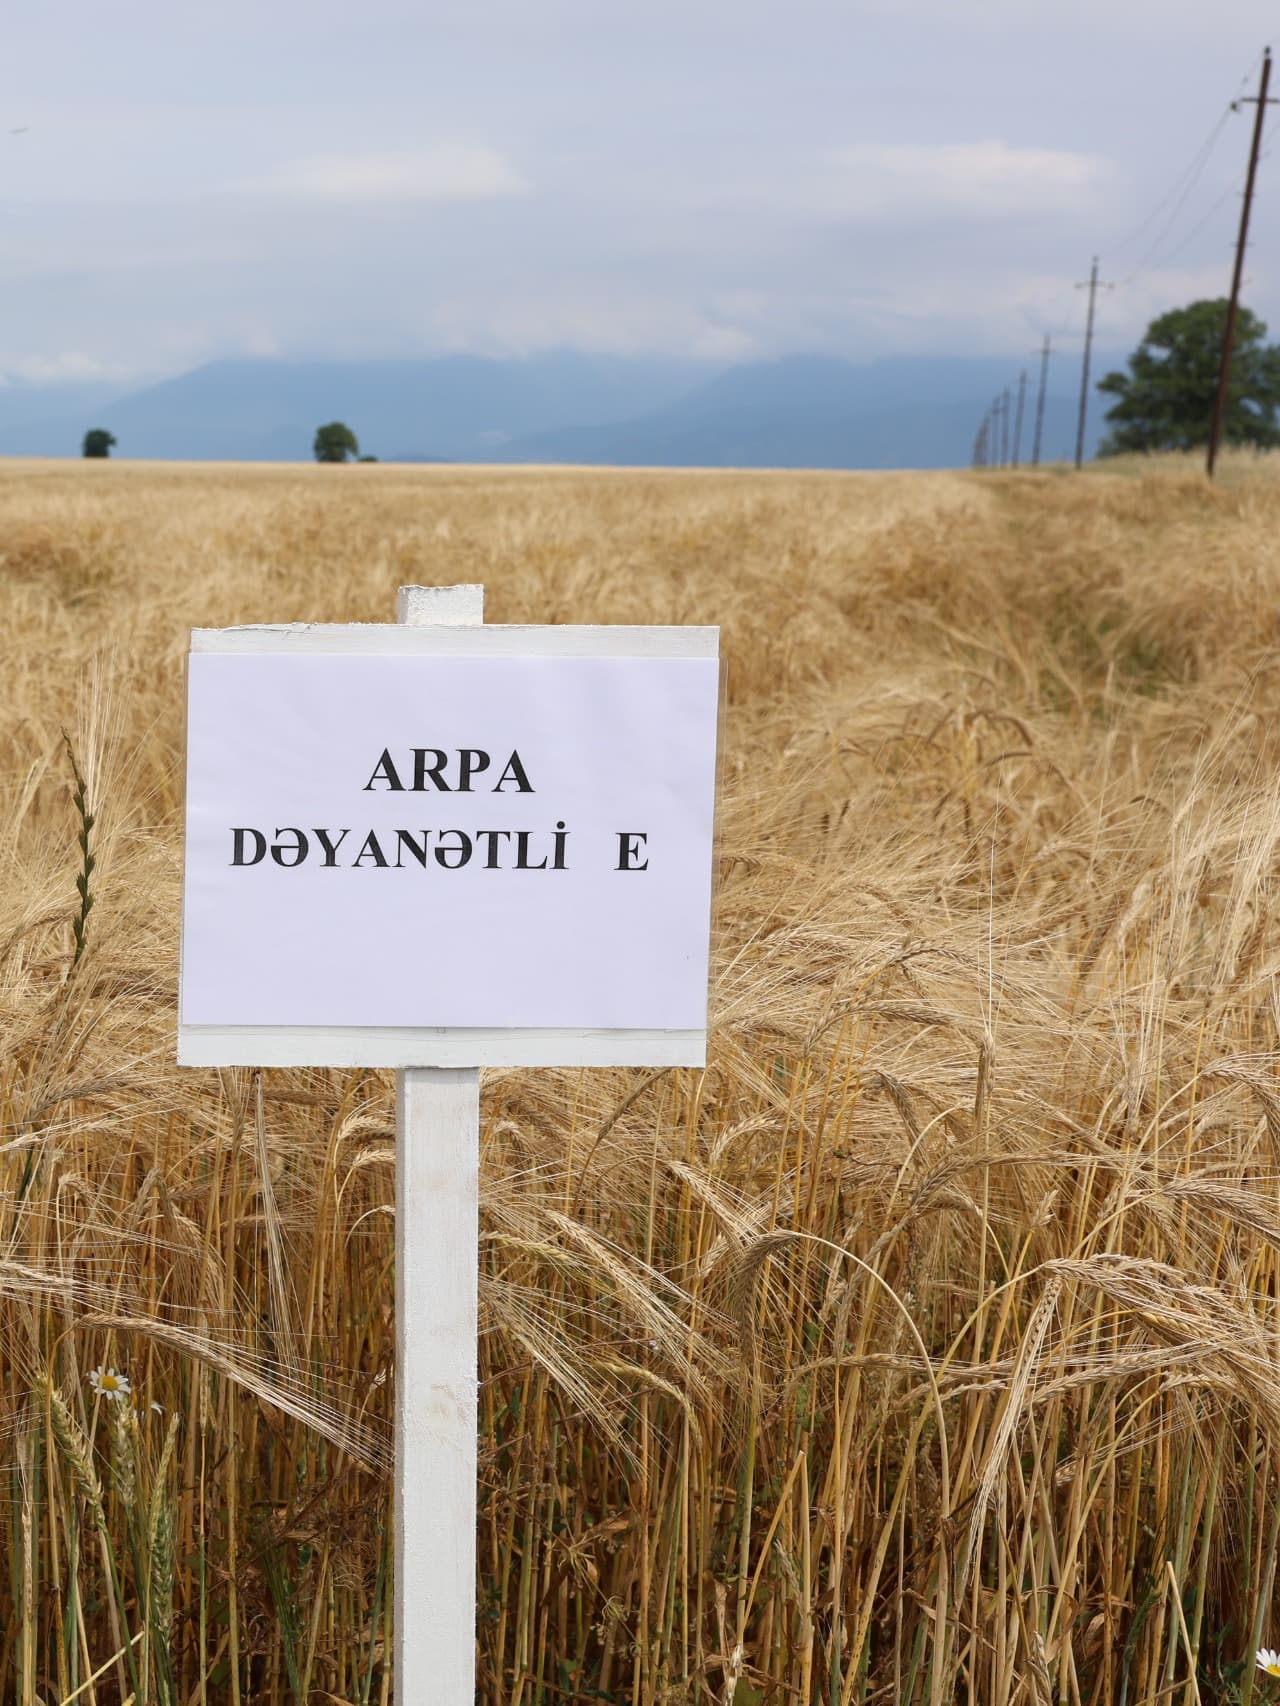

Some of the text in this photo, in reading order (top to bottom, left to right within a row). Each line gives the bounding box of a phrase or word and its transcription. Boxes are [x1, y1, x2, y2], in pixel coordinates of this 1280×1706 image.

[362, 747, 537, 793] ARPA
[229, 820, 649, 871] DƏYANƏTLİ E
